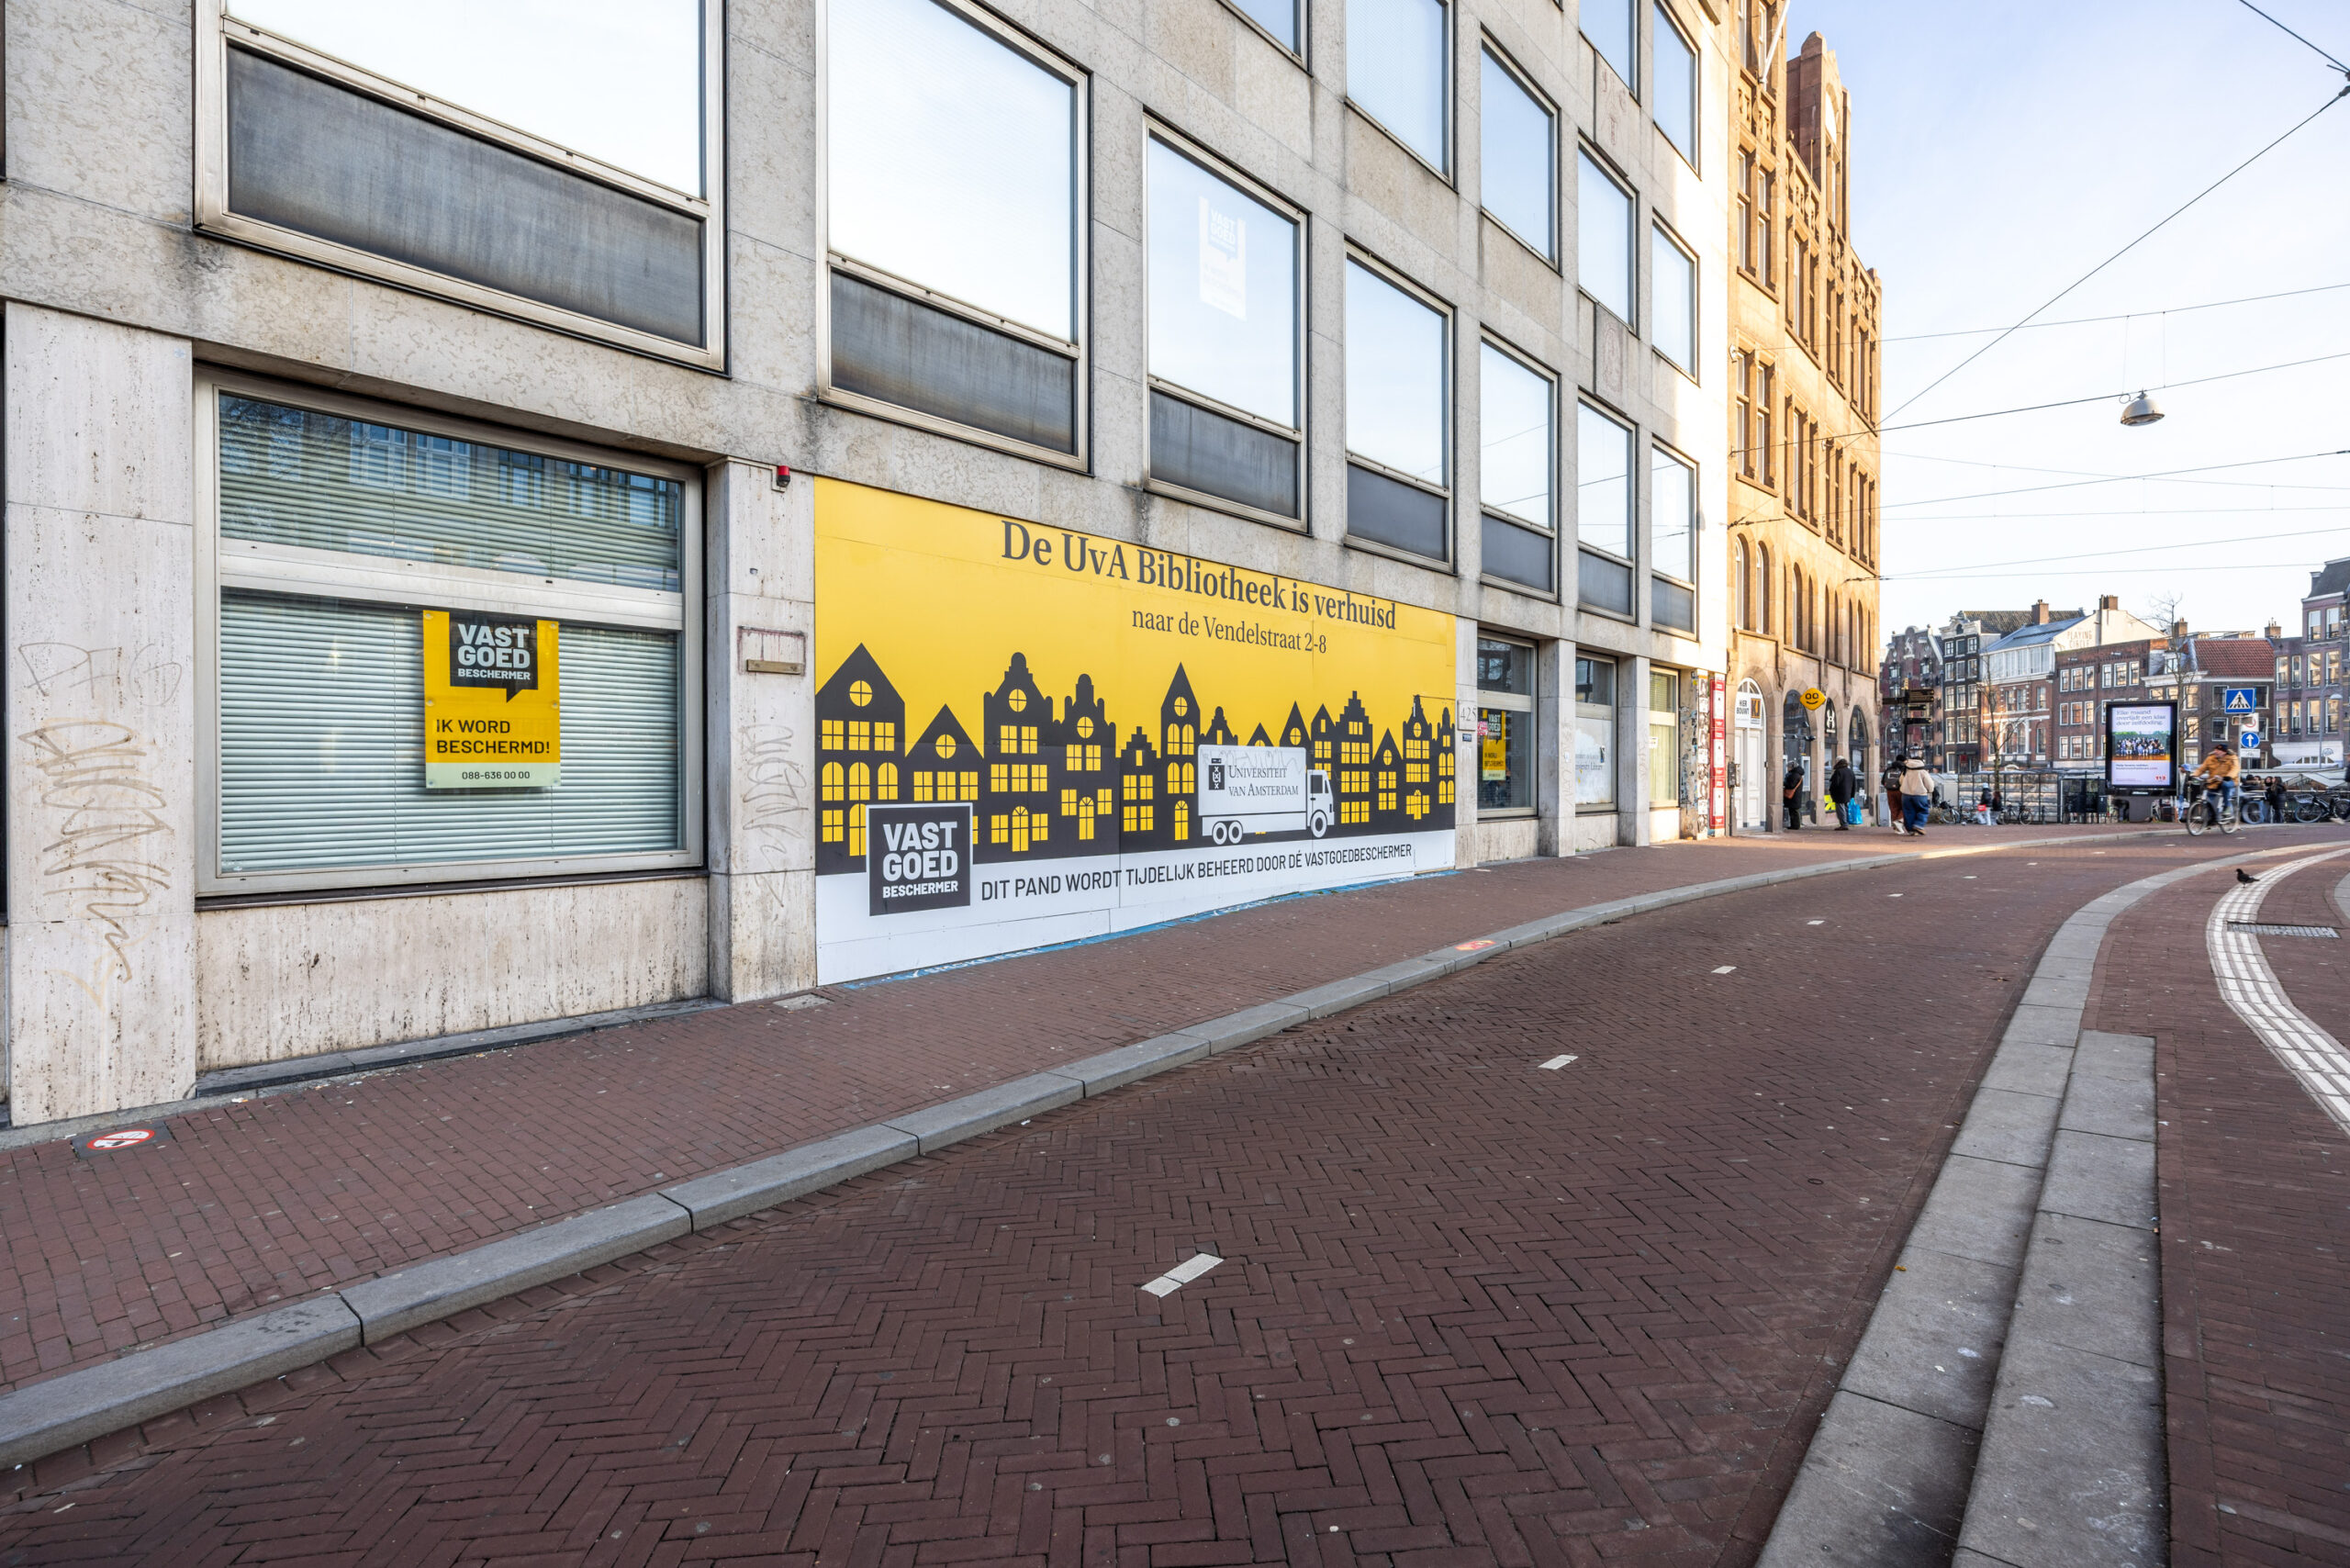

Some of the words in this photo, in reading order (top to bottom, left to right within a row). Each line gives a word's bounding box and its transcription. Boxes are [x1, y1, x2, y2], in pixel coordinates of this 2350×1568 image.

[1001, 520, 1052, 566] De
[1061, 532, 1130, 581] UvA
[1136, 549, 1286, 610] Bibliotheek
[1292, 582, 1309, 614] is
[1314, 592, 1396, 631] verhuisd
[457, 623, 530, 648] VAST
[1132, 609, 1173, 633] naar
[1178, 611, 1200, 636] de
[1203, 615, 1302, 652] Vendelstraat
[1304, 633, 1327, 654] 2-8
[457, 645, 531, 668] GOED
[457, 667, 531, 680] BESCHERMER
[436, 719, 453, 733] IK
[458, 720, 510, 734] WORD
[1488, 714, 1501, 722] VAST
[437, 740, 550, 754] BESCHERMD!
[462, 771, 502, 779] 088-636
[504, 771, 516, 779] 00
[518, 771, 530, 779] 00
[883, 822, 957, 852] VAST
[882, 849, 958, 881] GOED
[981, 879, 1010, 901] DIT
[1015, 875, 1061, 898] PAND
[1065, 869, 1123, 891] WORDT
[1126, 863, 1195, 886] TIJDELIJK
[1197, 857, 1254, 879] BEHEERD
[1257, 855, 1286, 872] DOOR
[1288, 849, 1303, 870] DÉ
[1304, 844, 1412, 867] VASTGOEDBESCHERMER
[882, 880, 958, 899] BESCHERMER
